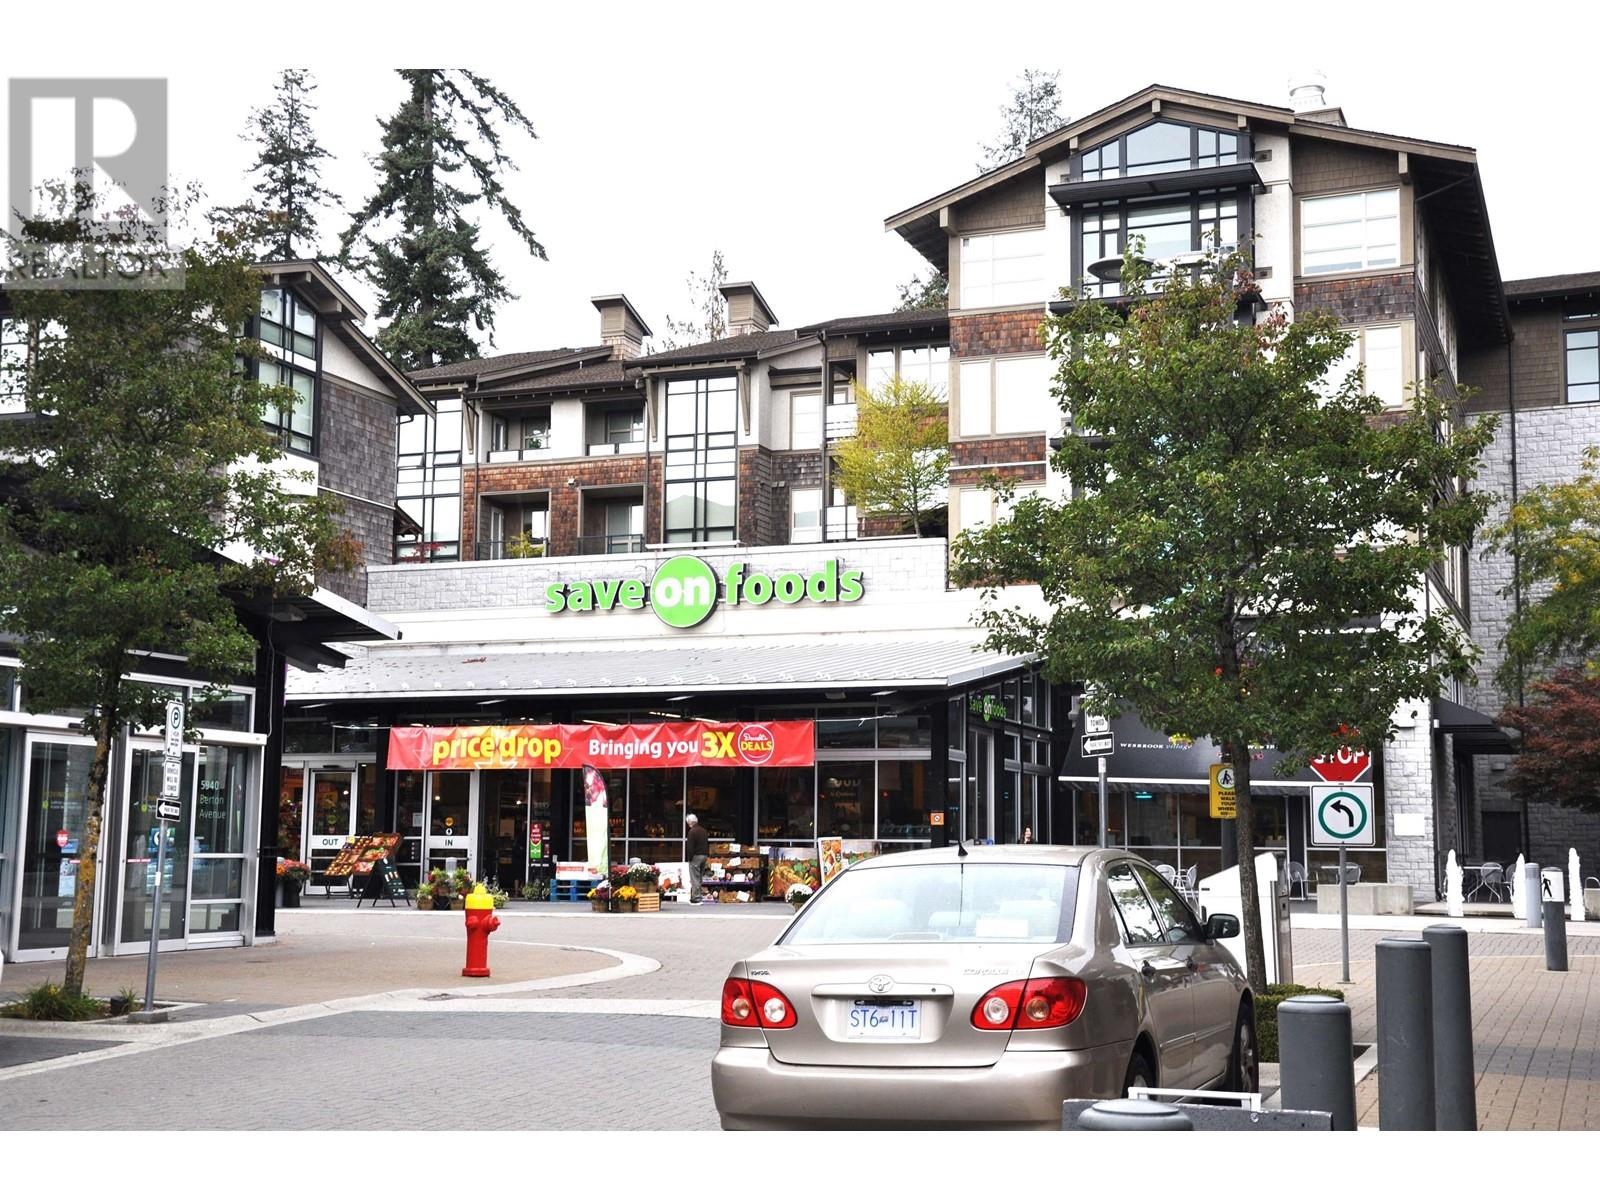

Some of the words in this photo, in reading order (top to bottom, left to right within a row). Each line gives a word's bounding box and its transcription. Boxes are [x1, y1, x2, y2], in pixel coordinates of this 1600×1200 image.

[544, 576, 647, 613] save
[653, 575, 713, 608] on
[723, 557, 865, 606] foods
[589, 739, 662, 760] Bringing
[667, 739, 698, 758] you
[702, 732, 737, 758] 3X
[741, 741, 773, 751] DEALS
[1314, 744, 1366, 764] OP
[201, 780, 220, 790] 5940
[199, 809, 227, 819] Avenue
[322, 838, 339, 847] OUT
[445, 839, 454, 847] IN
